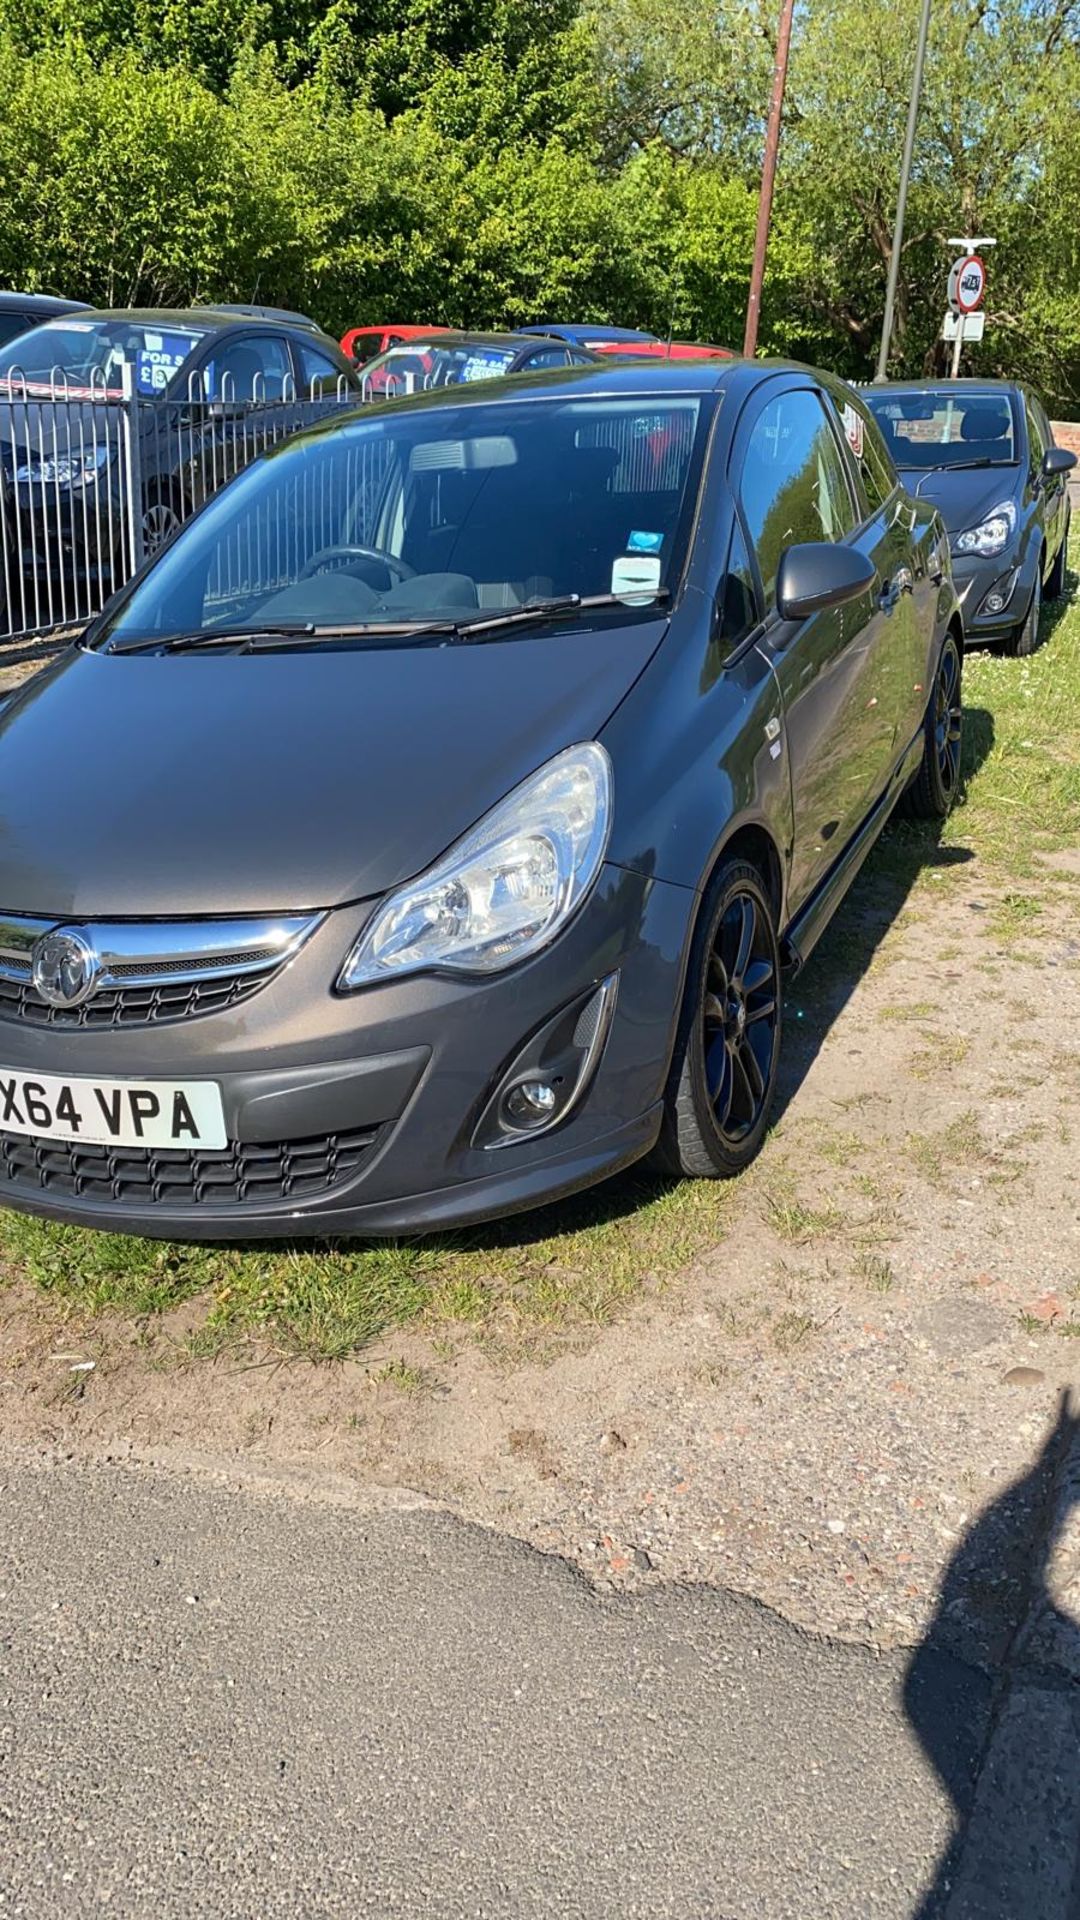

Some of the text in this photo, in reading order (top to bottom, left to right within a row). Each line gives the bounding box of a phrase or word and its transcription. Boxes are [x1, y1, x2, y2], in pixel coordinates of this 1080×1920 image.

[141, 351, 171, 365] FOR
[467, 357, 507, 370] FOR SAL
[0, 1079, 200, 1139] X64 VPA
